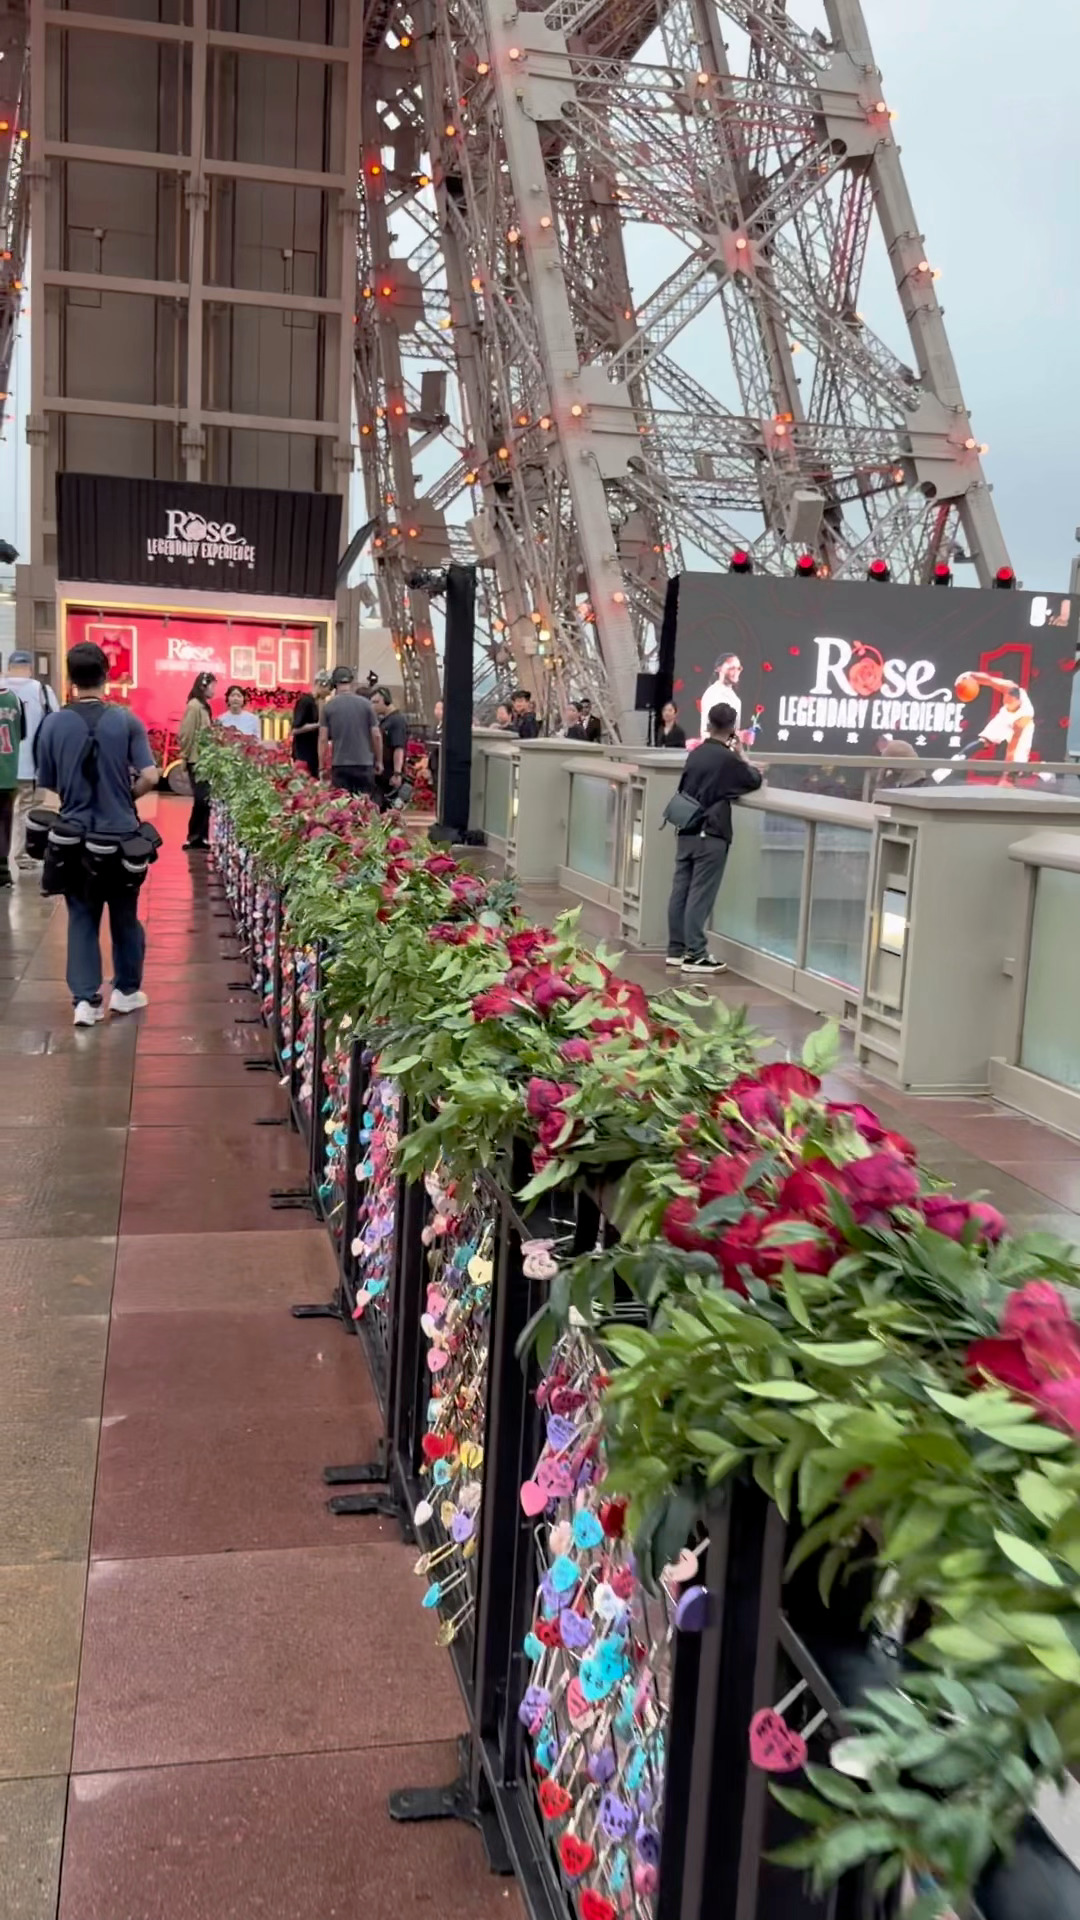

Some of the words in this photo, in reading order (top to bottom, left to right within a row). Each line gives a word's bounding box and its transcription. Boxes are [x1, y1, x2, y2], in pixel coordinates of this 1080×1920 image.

[165, 509, 247, 545] Rose
[147, 538, 200, 557] LEGENDARY
[201, 543, 256, 562] EXPERIENCE
[810, 636, 953, 703] Rose
[778, 695, 869, 730] LEGENDARY
[872, 699, 966, 733] EXPERIENCE
